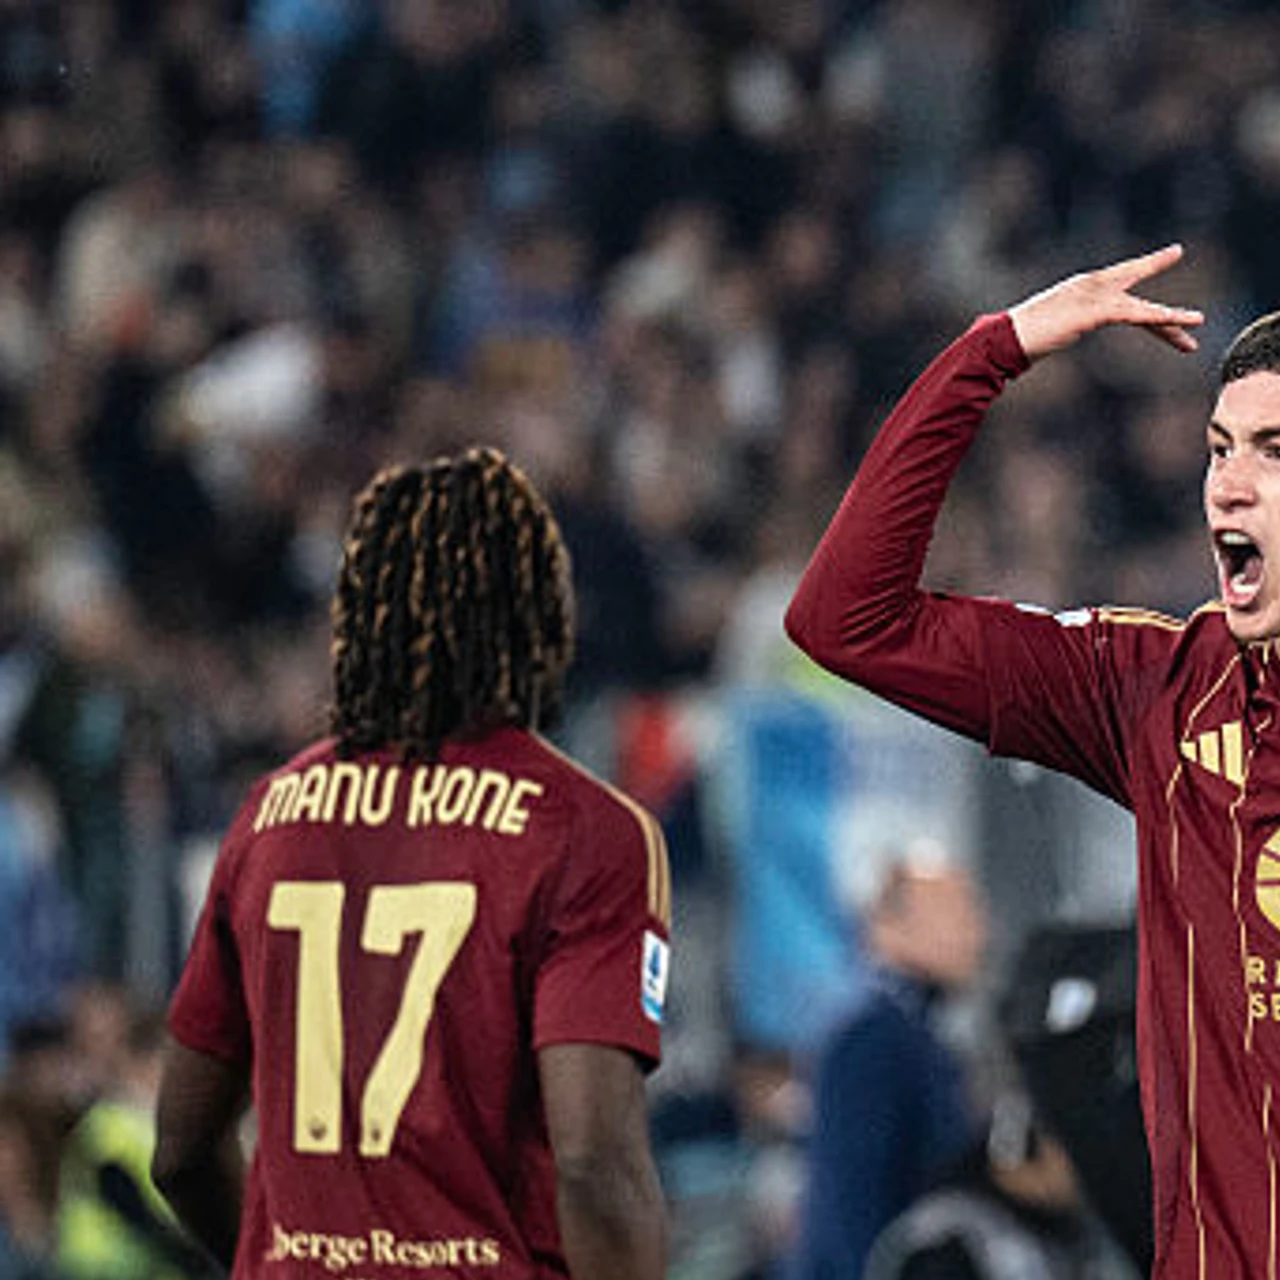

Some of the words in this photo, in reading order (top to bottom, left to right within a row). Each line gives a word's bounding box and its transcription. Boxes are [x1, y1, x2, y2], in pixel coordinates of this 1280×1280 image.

[253, 762, 400, 834] MANU
[407, 765, 543, 836] KONE
[267, 881, 477, 1157] 17
[266, 1223, 368, 1272] berge
[370, 1229, 500, 1269] Resorts
